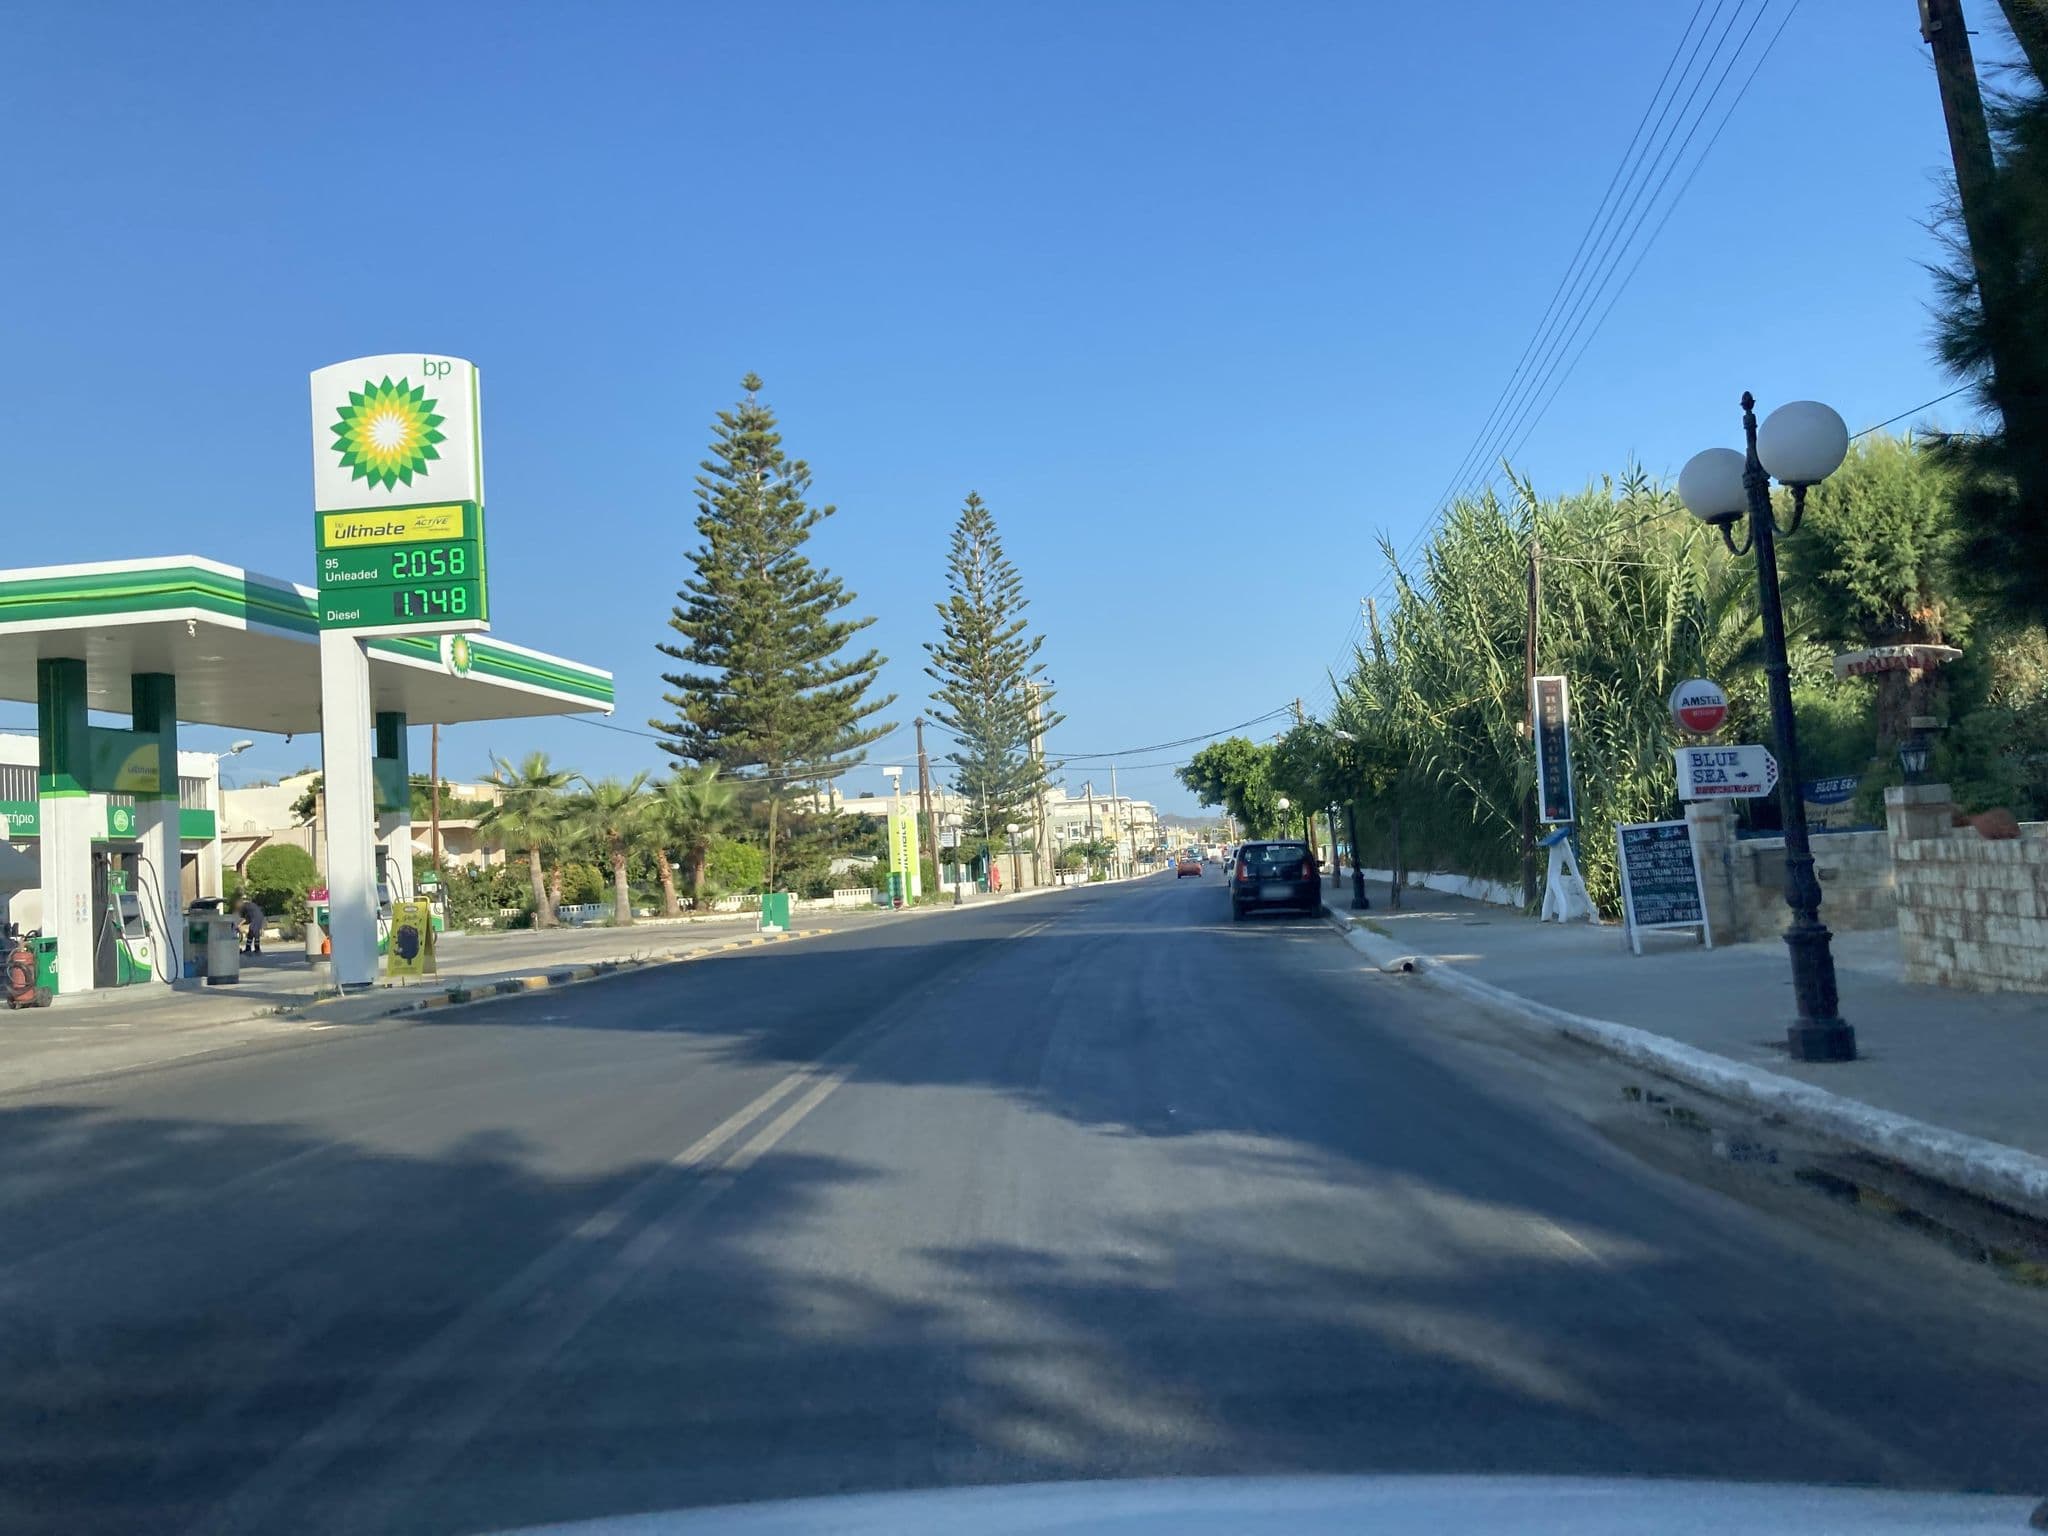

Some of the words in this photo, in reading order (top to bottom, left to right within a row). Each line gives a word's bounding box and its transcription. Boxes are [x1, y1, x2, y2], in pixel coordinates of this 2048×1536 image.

[423, 357, 451, 380] bp
[415, 517, 449, 527] ACTIVE
[334, 522, 405, 540] ultimate
[325, 558, 339, 569] 95
[393, 547, 465, 579] 2.058
[325, 568, 378, 582] Unleaded
[403, 586, 466, 616] 1.748
[327, 609, 360, 621] Diesel
[1681, 696, 1722, 706] AMSTEL
[1691, 752, 1739, 767] BLUE
[1693, 769, 1729, 784] SEA
[1815, 780, 1839, 793] BLUE
[7, 810, 35, 827] τήριο
